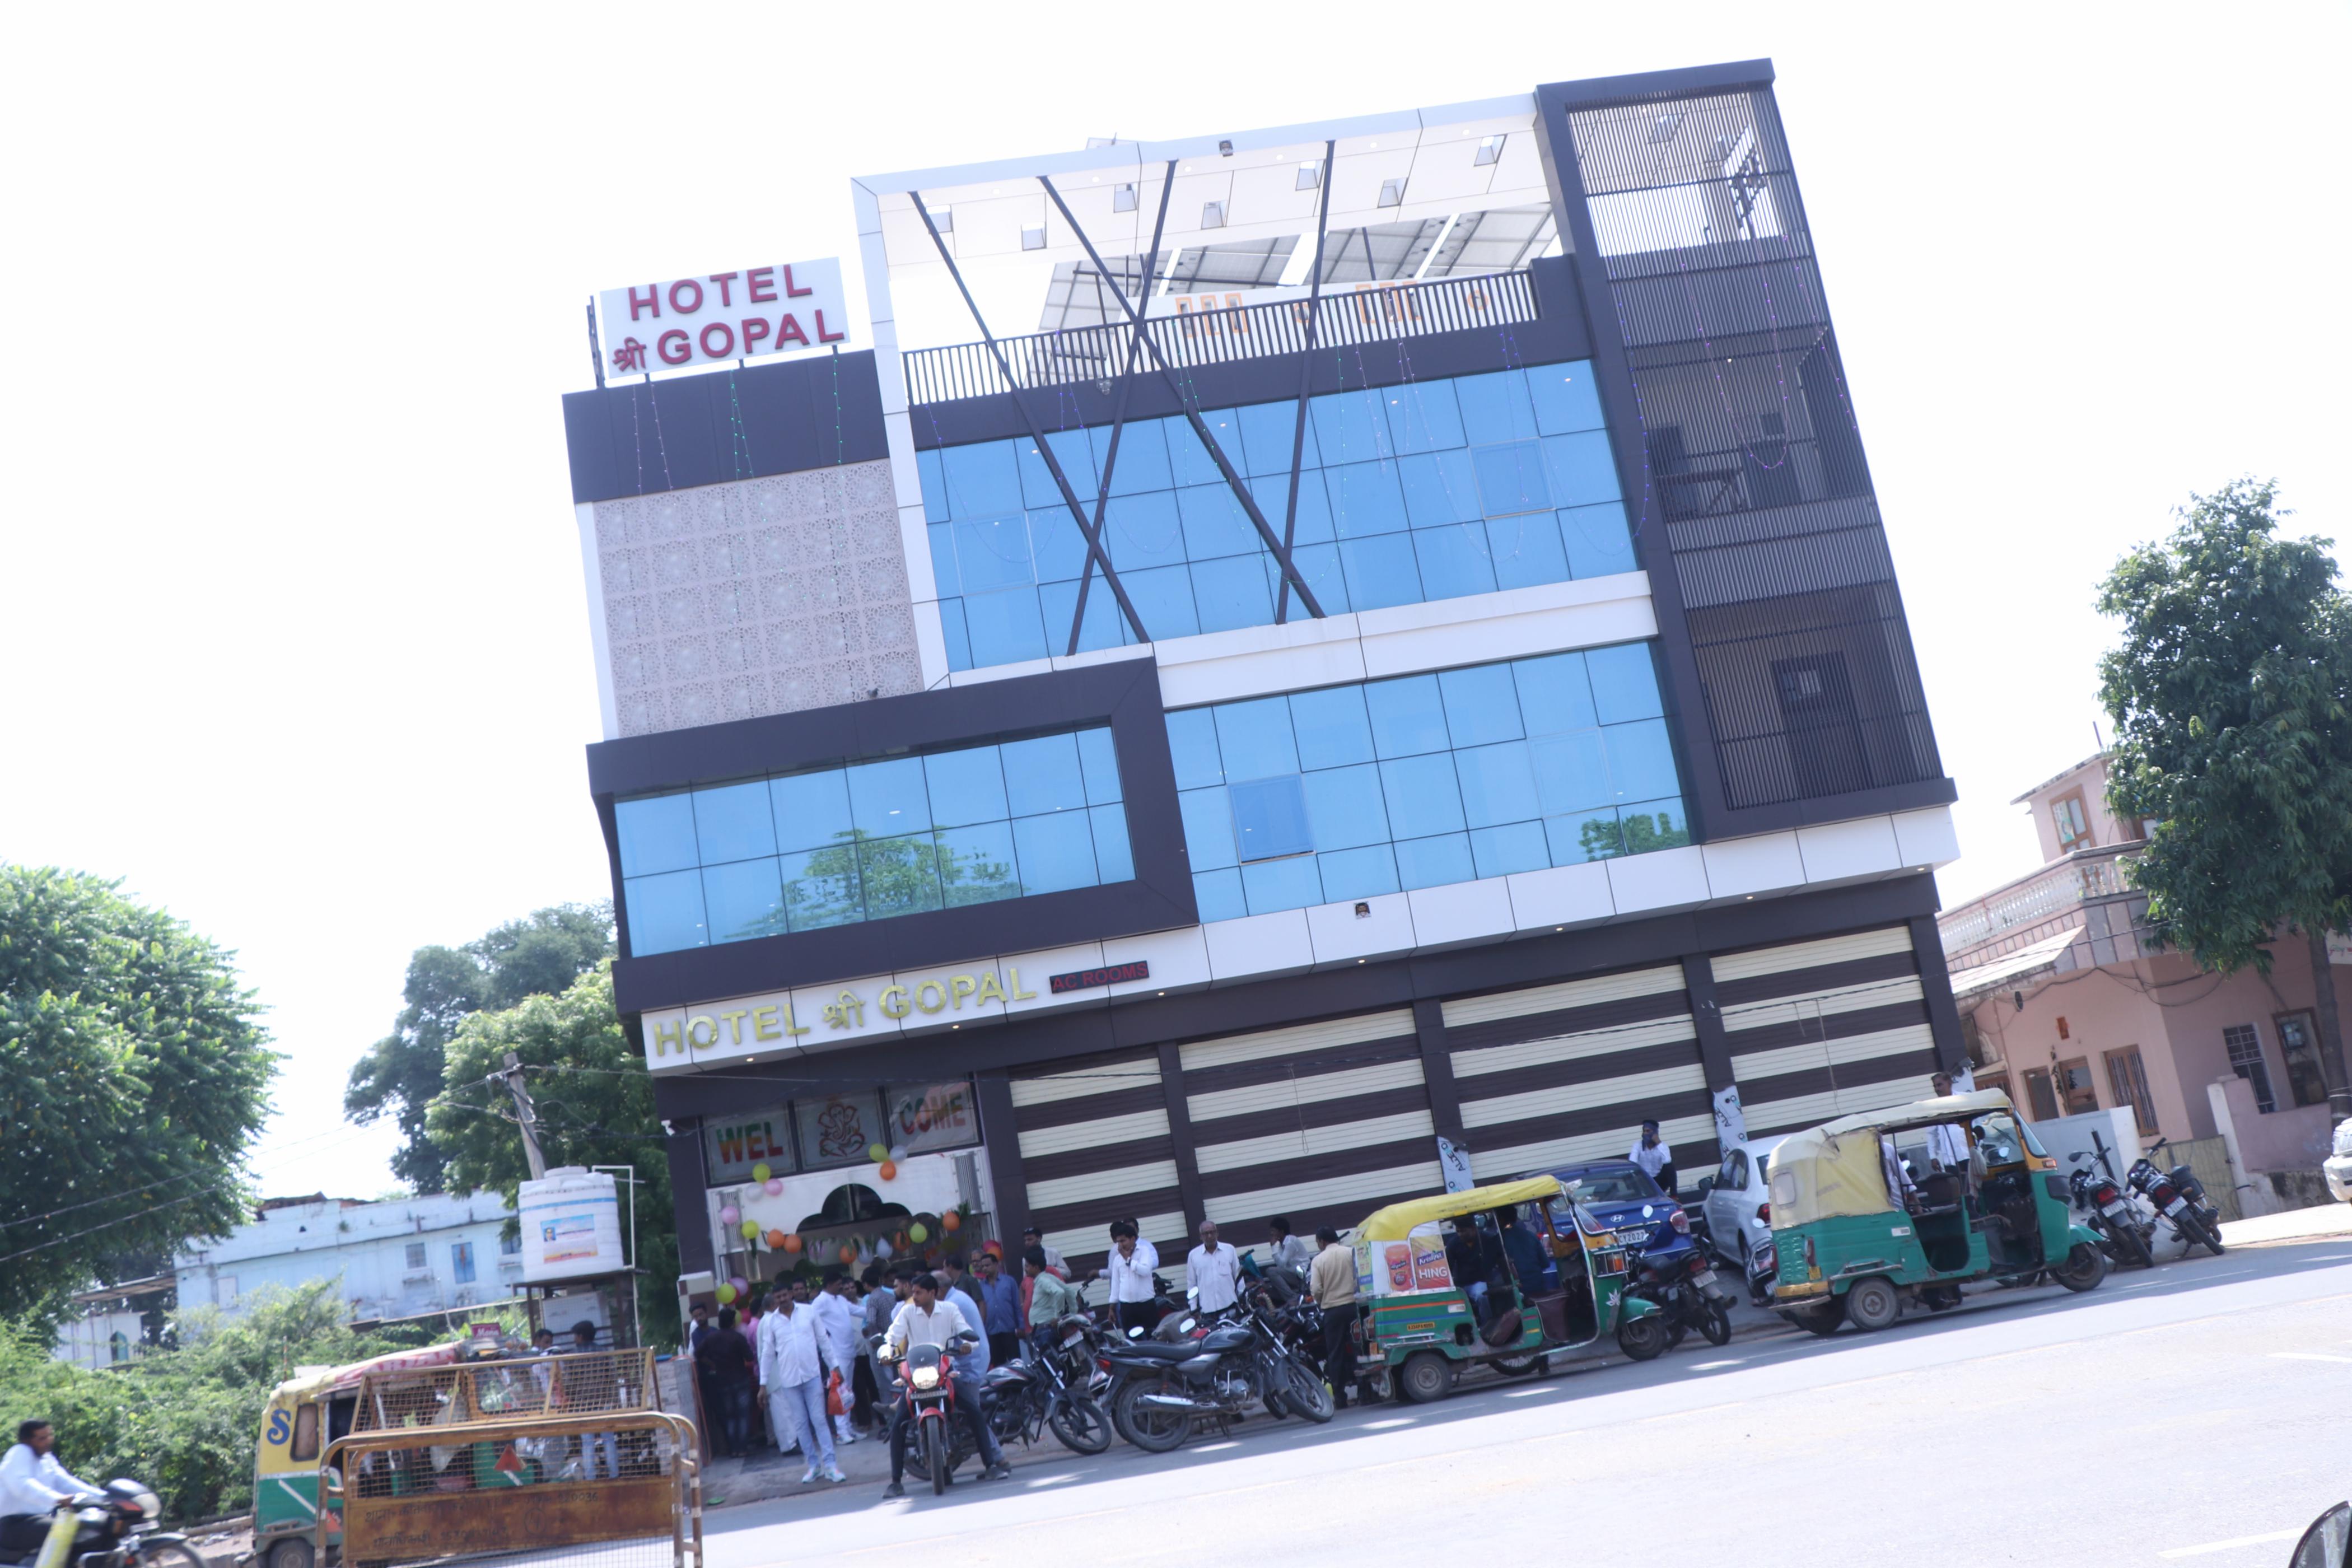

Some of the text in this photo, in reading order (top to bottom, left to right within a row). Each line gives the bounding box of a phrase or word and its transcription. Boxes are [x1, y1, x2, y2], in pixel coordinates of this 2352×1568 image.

[628, 264, 812, 321] HOTEL
[612, 309, 845, 372] श्री GOPAL
[1052, 962, 1148, 990] AC ROOMS
[653, 967, 1037, 1056] HOTEL श्री GOPAL
[716, 1093, 966, 1164] WEL COME
[1418, 1267, 1448, 1279] HING
[267, 1408, 291, 1445] S
